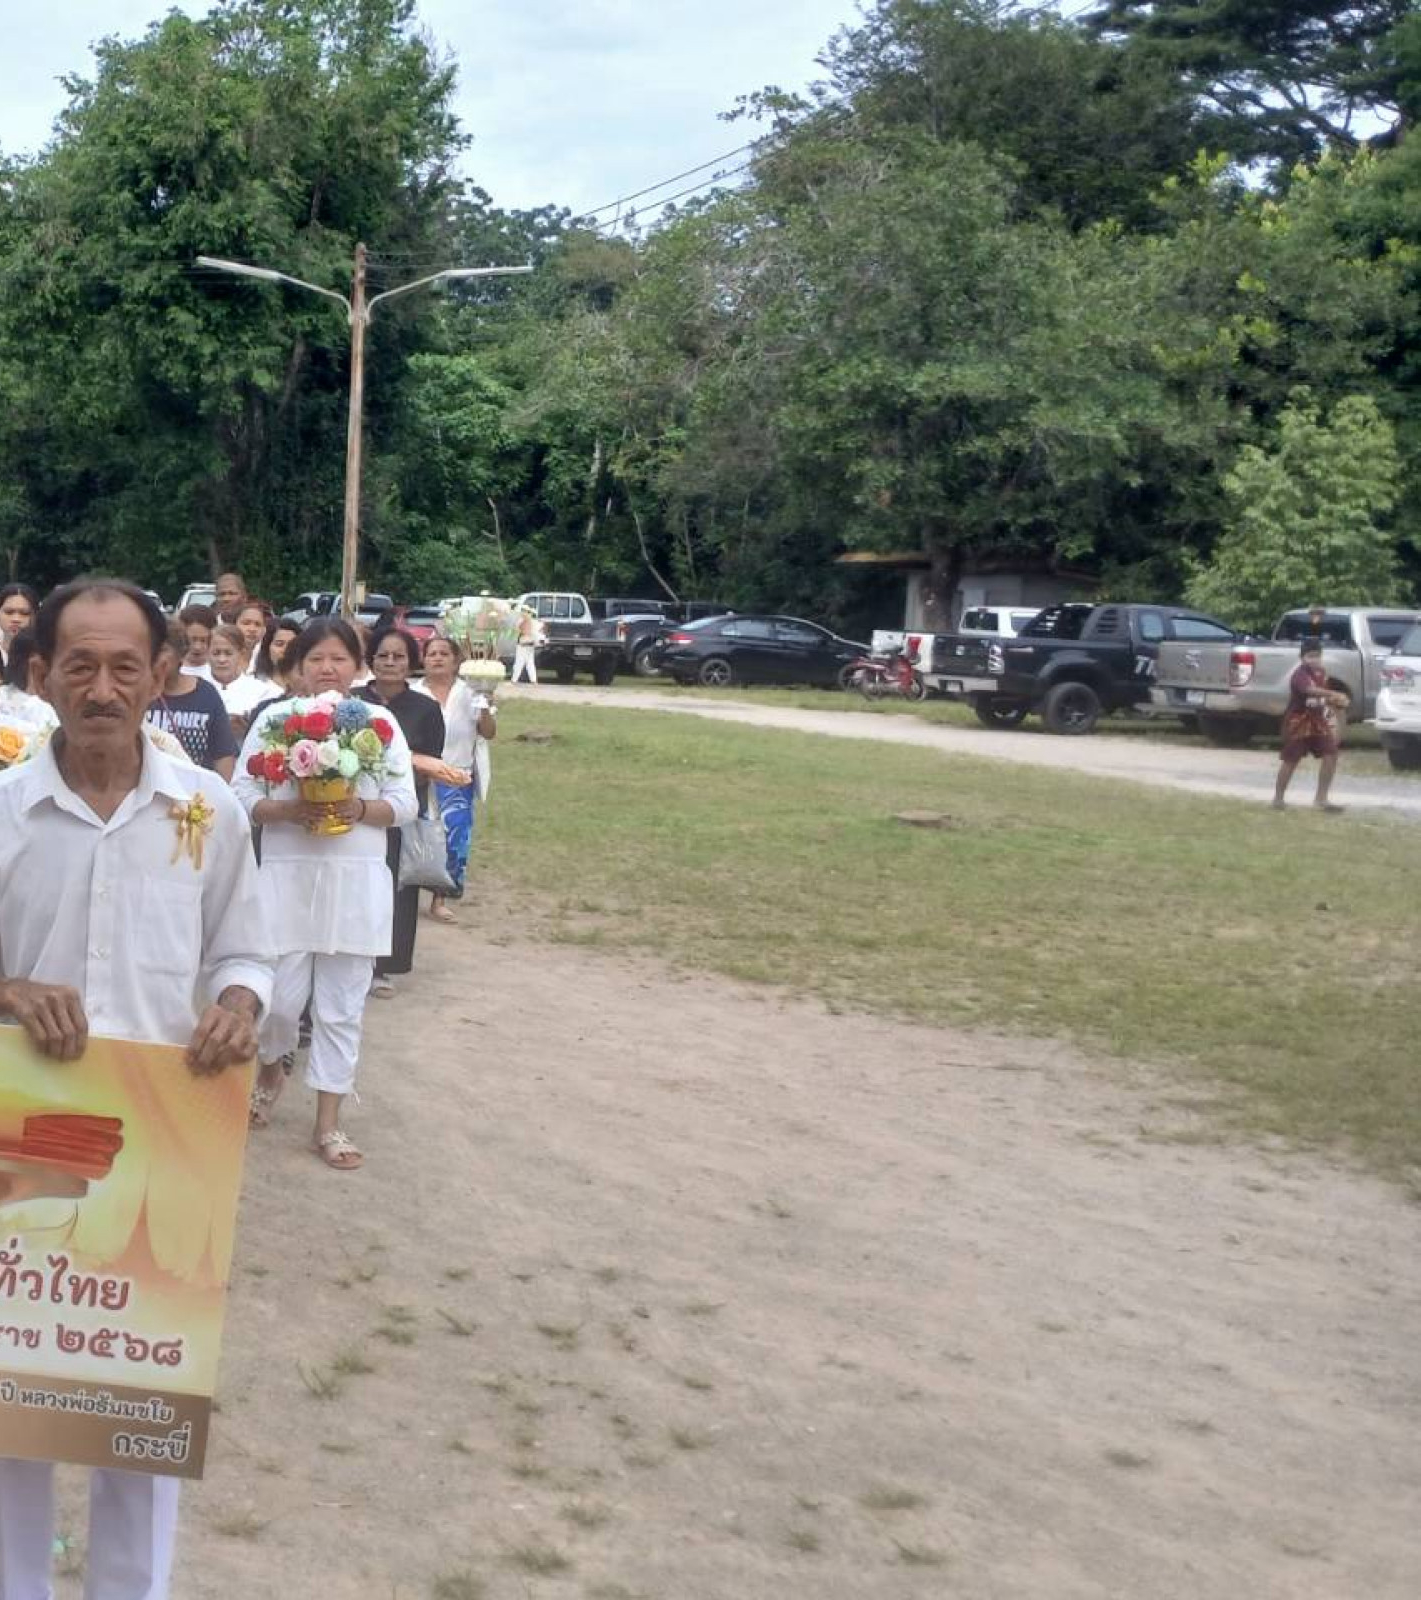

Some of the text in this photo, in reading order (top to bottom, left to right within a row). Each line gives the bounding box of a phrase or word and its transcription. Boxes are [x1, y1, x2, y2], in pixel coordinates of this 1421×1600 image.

[56, 1323, 184, 1366] ๒๕๖๘
[0, 1380, 16, 1402] ปี
[114, 1424, 191, 1461] กระบี่
